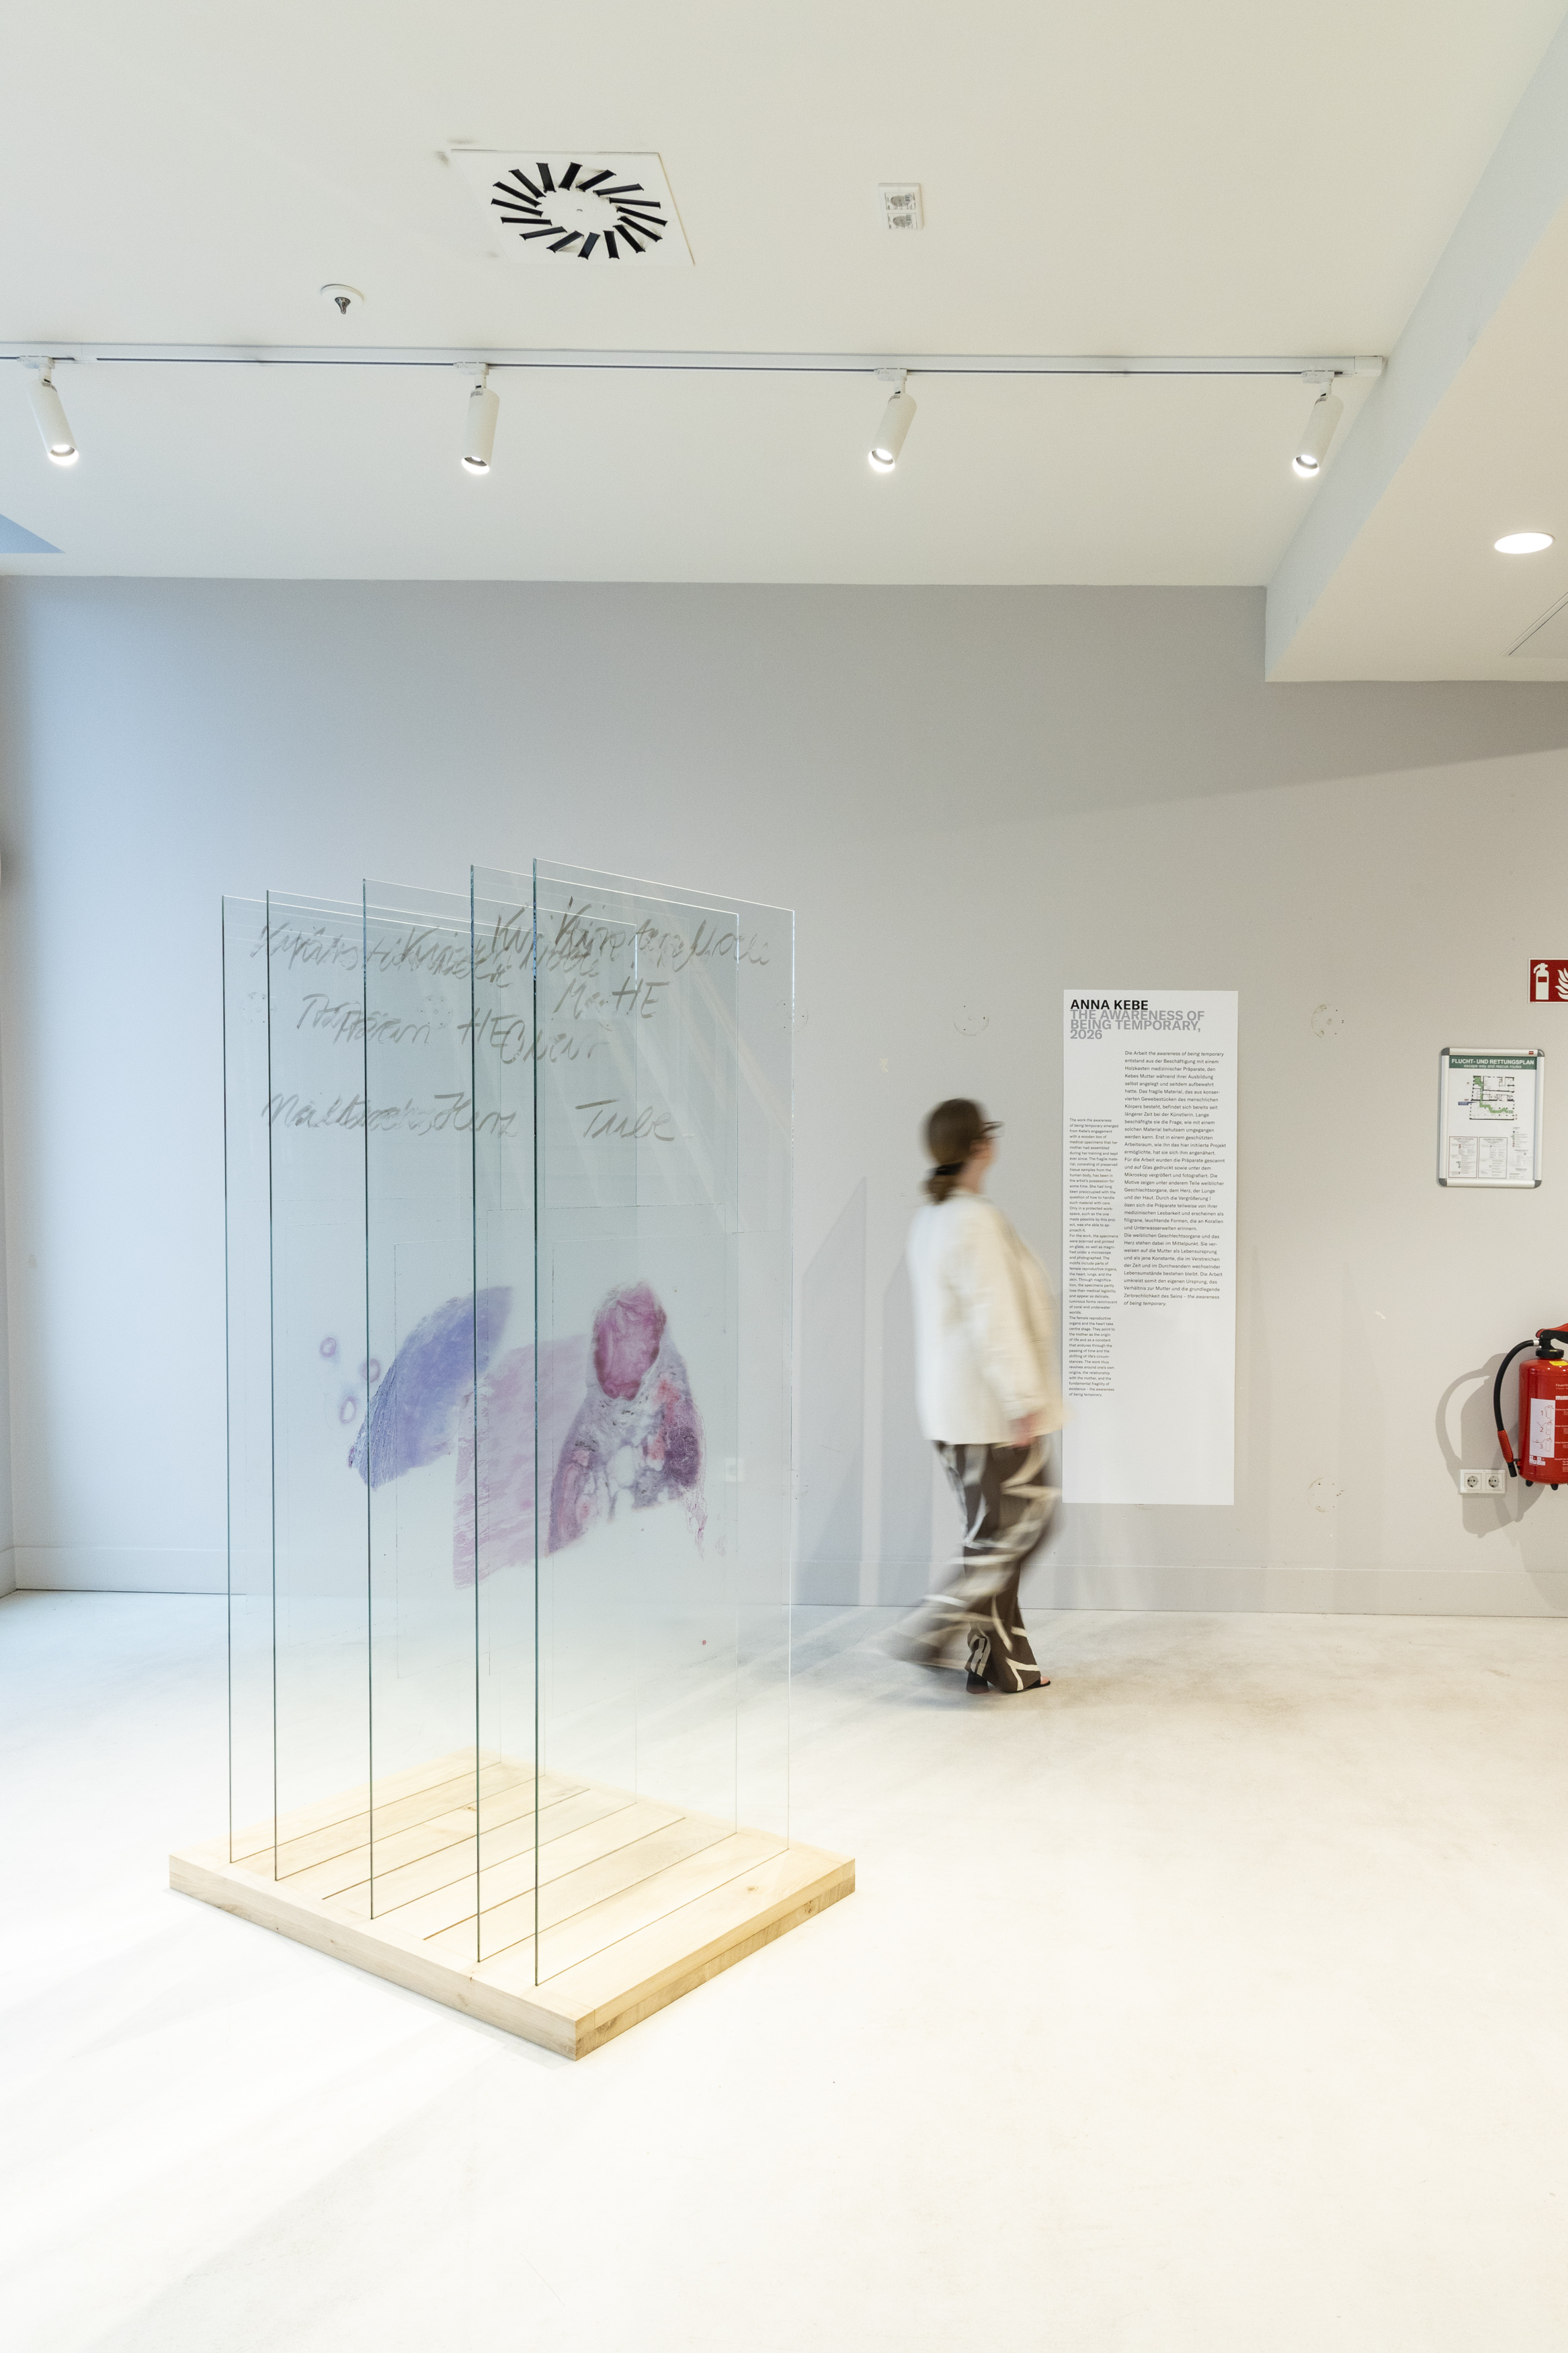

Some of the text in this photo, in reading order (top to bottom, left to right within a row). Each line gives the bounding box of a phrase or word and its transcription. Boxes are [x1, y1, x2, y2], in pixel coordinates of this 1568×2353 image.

[1070, 1000, 1148, 1010] ANNA KEBE
[1070, 1010, 1204, 1021] THE AWARENESS OF
[1071, 1019, 1201, 1033] BEING TEMPORARY,
[1070, 1029, 1102, 1039] 2026
